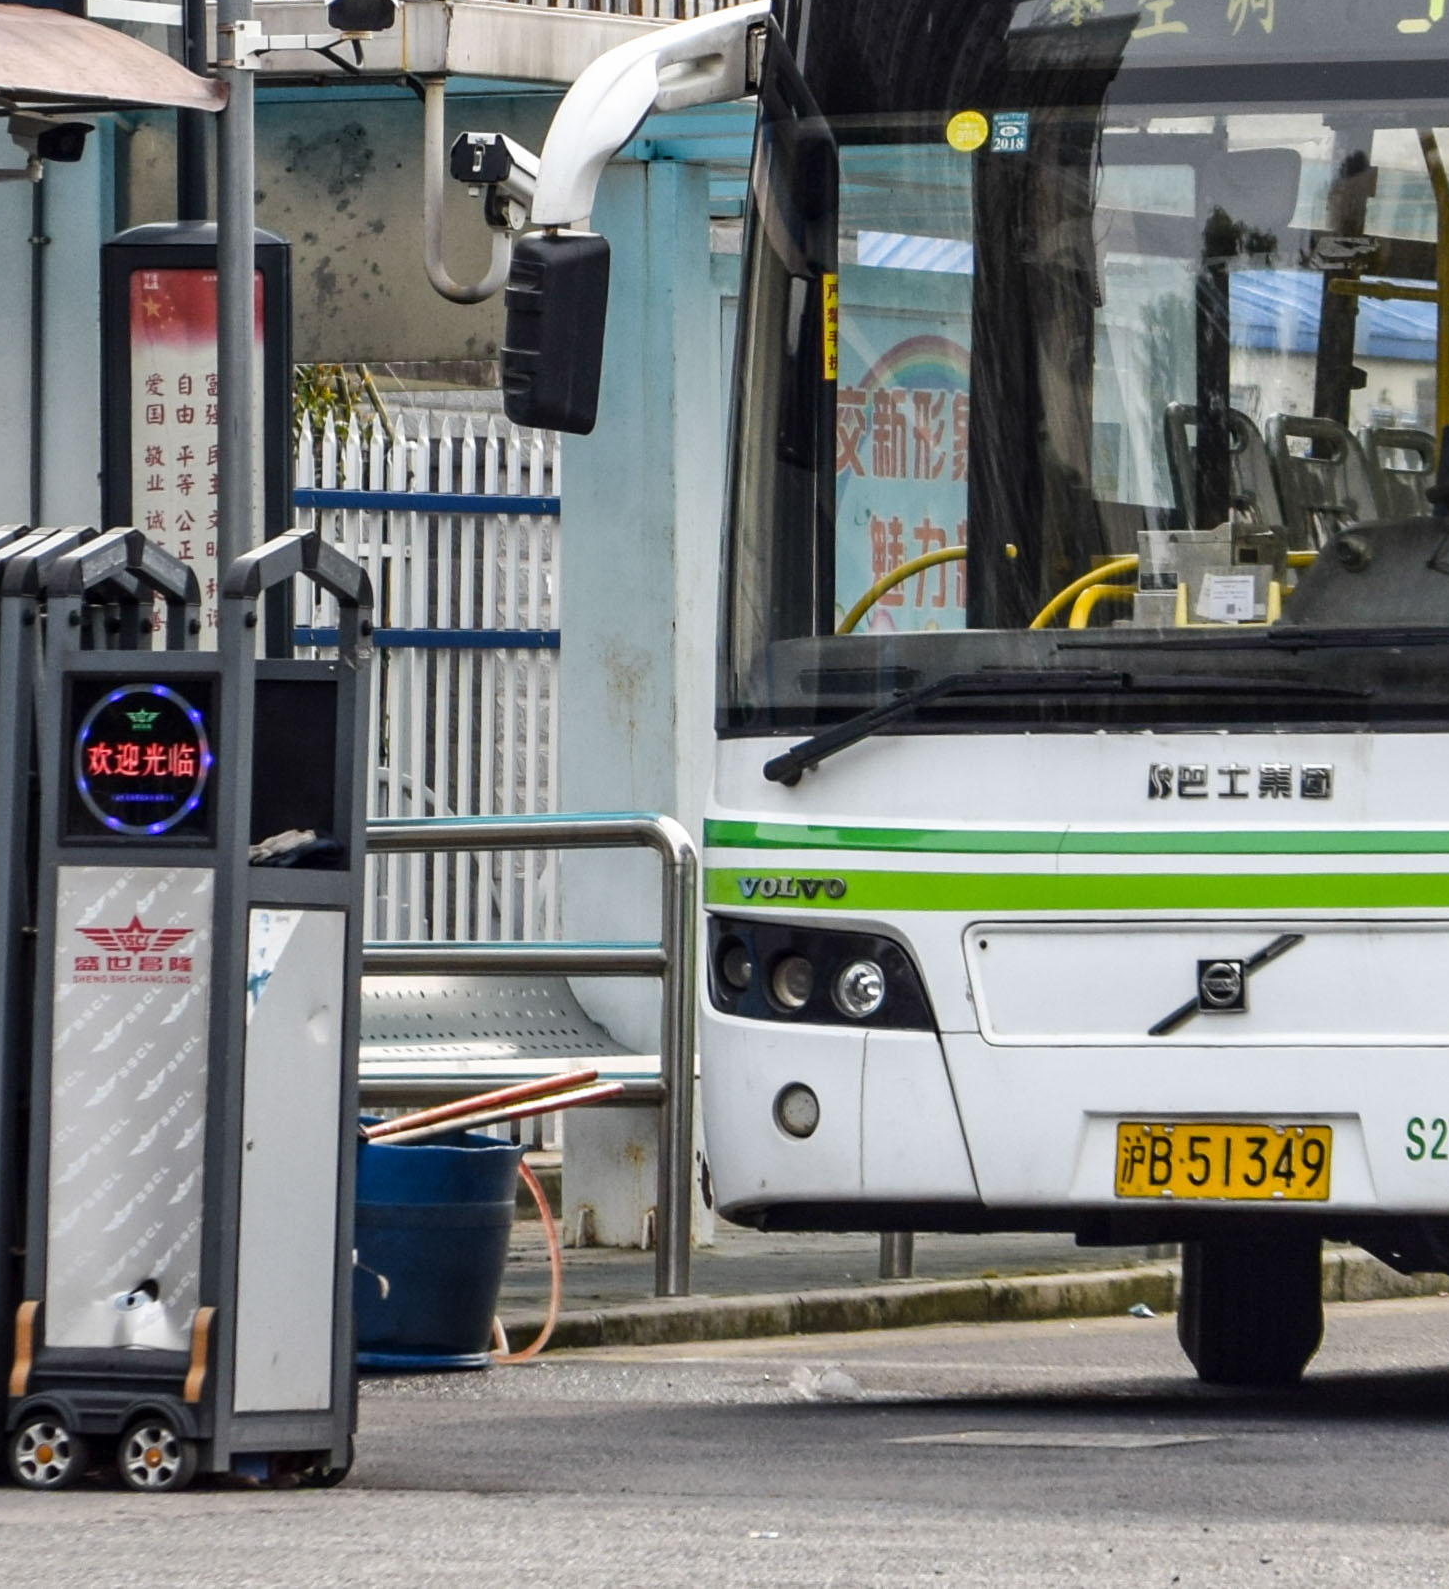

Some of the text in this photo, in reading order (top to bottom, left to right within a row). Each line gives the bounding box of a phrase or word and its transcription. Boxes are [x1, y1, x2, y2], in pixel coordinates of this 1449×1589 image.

[993, 137, 1024, 152] 2018
[145, 373, 165, 425] 爱国
[144, 445, 166, 492] 敬业
[175, 373, 195, 561] 自由 平等 公正
[87, 741, 196, 777] 欢迎光临
[738, 876, 847, 900] VOLVO
[73, 975, 192, 985] SHENG SHI CHANG LONG
